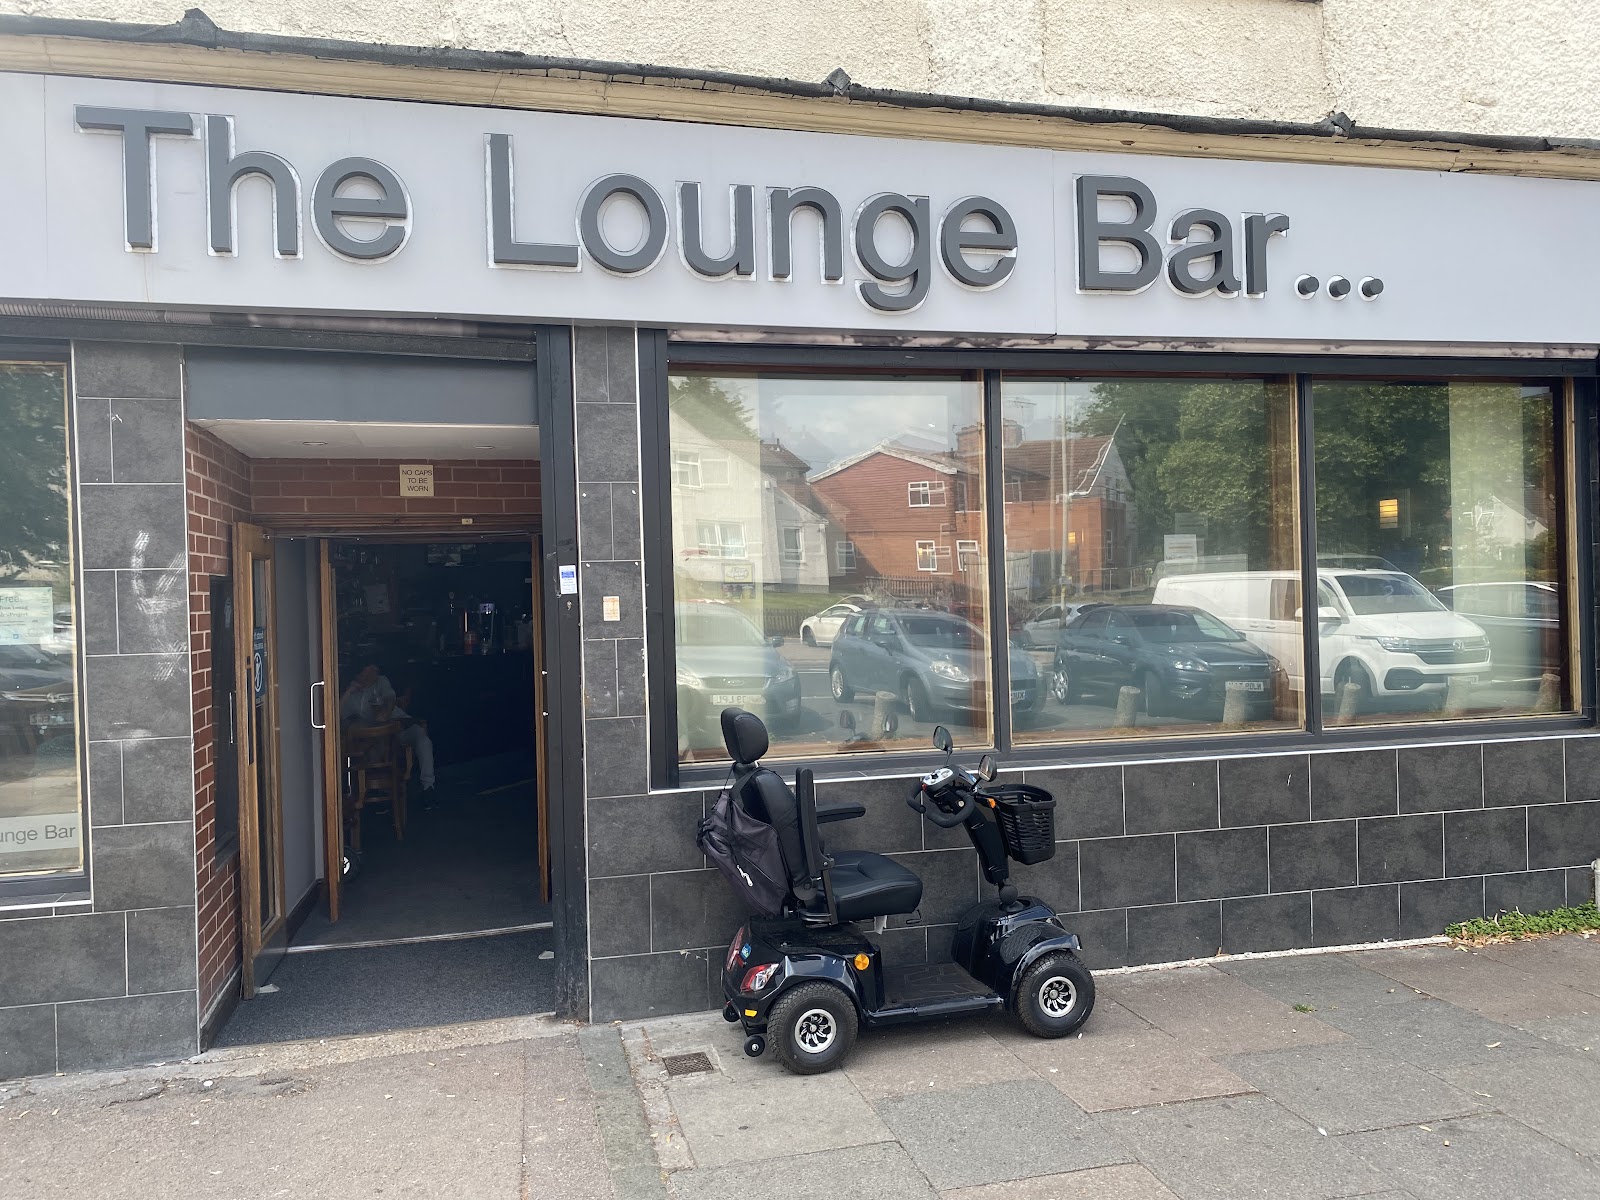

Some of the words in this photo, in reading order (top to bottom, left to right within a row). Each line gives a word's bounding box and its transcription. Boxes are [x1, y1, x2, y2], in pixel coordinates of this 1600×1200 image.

[75, 105, 409, 261] The
[485, 134, 1018, 312] Lounge
[414, 469, 432, 477] CAPS
[45, 824, 76, 840] Bar
